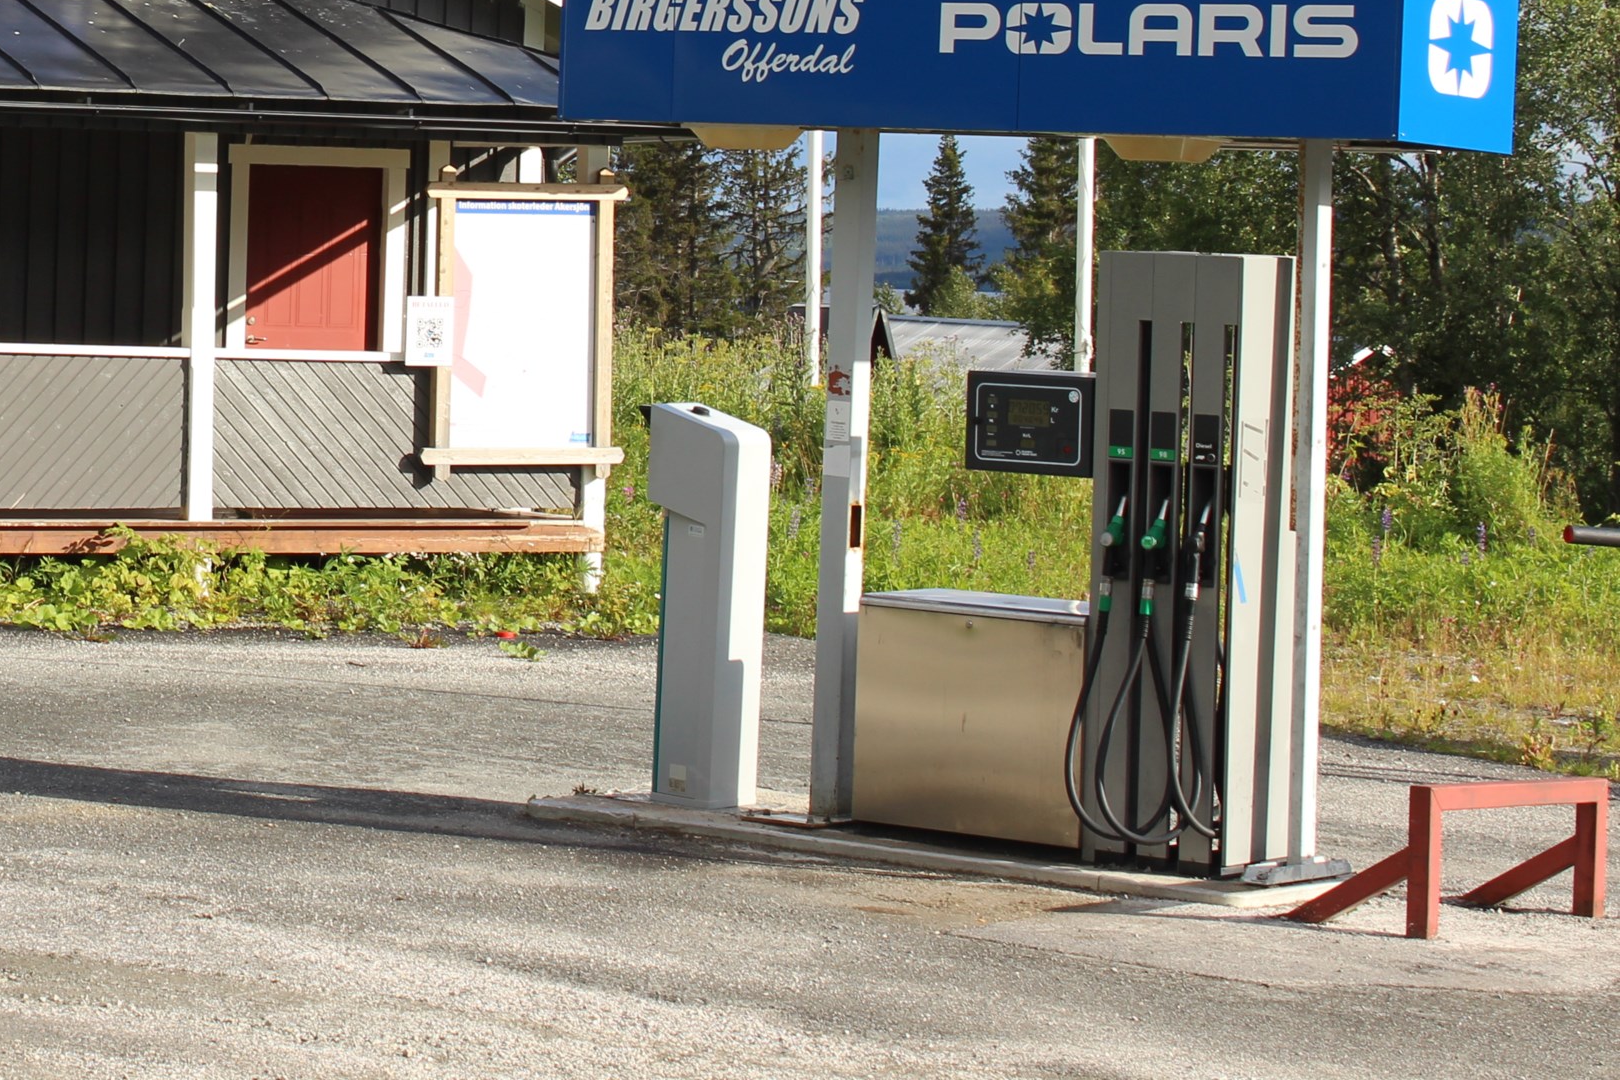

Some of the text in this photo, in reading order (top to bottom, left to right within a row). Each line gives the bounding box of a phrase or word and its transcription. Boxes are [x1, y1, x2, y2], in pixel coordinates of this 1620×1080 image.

[939, 2, 1359, 58] POLARIS
[721, 38, 856, 83] Offerdal
[458, 201, 507, 210] Information
